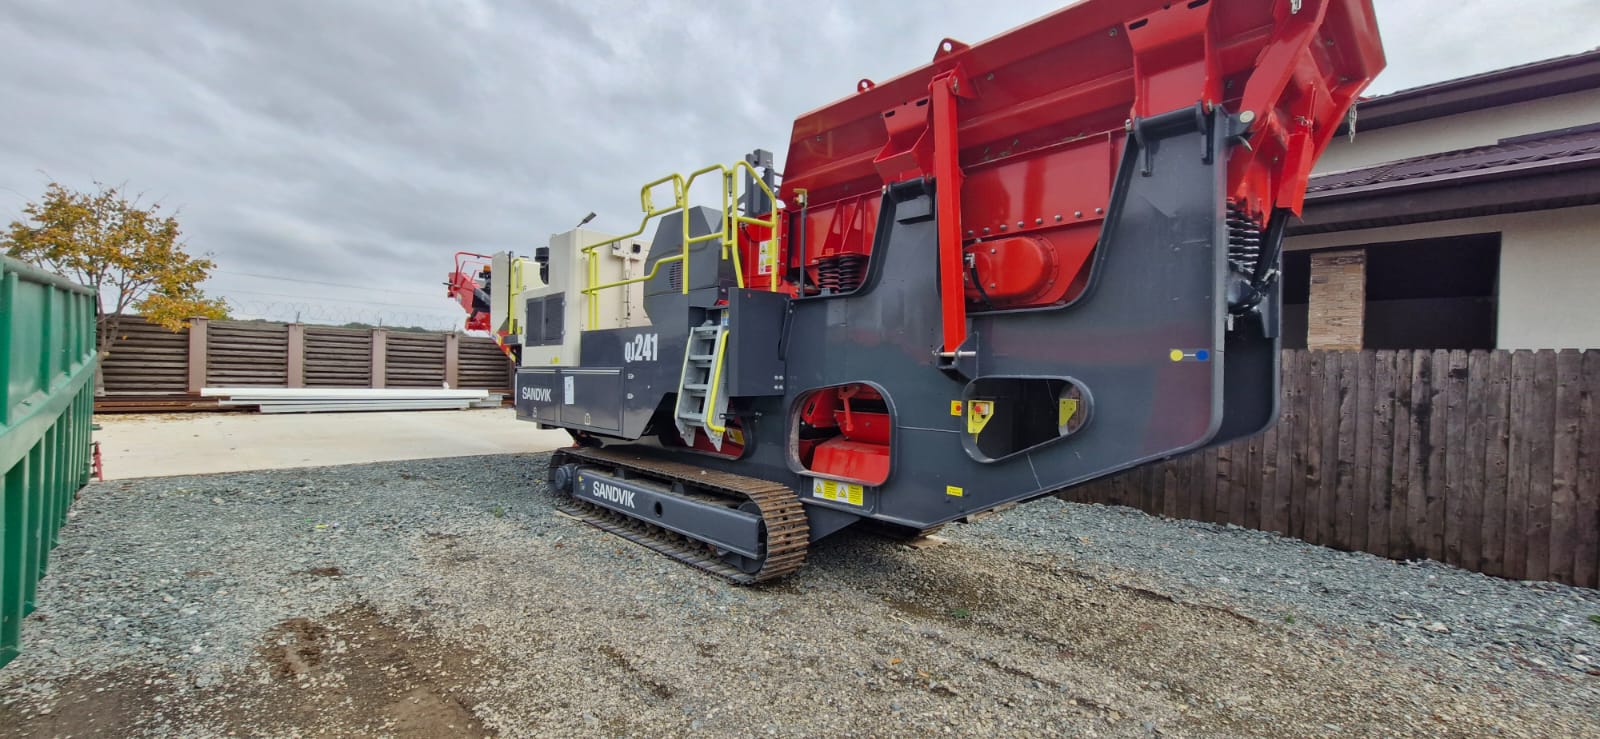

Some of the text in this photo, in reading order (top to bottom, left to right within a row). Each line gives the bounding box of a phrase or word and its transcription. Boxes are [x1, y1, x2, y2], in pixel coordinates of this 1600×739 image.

[624, 333, 658, 363] QJ241
[522, 386, 552, 403] SANDVIK
[593, 481, 636, 509] SANDVIK
